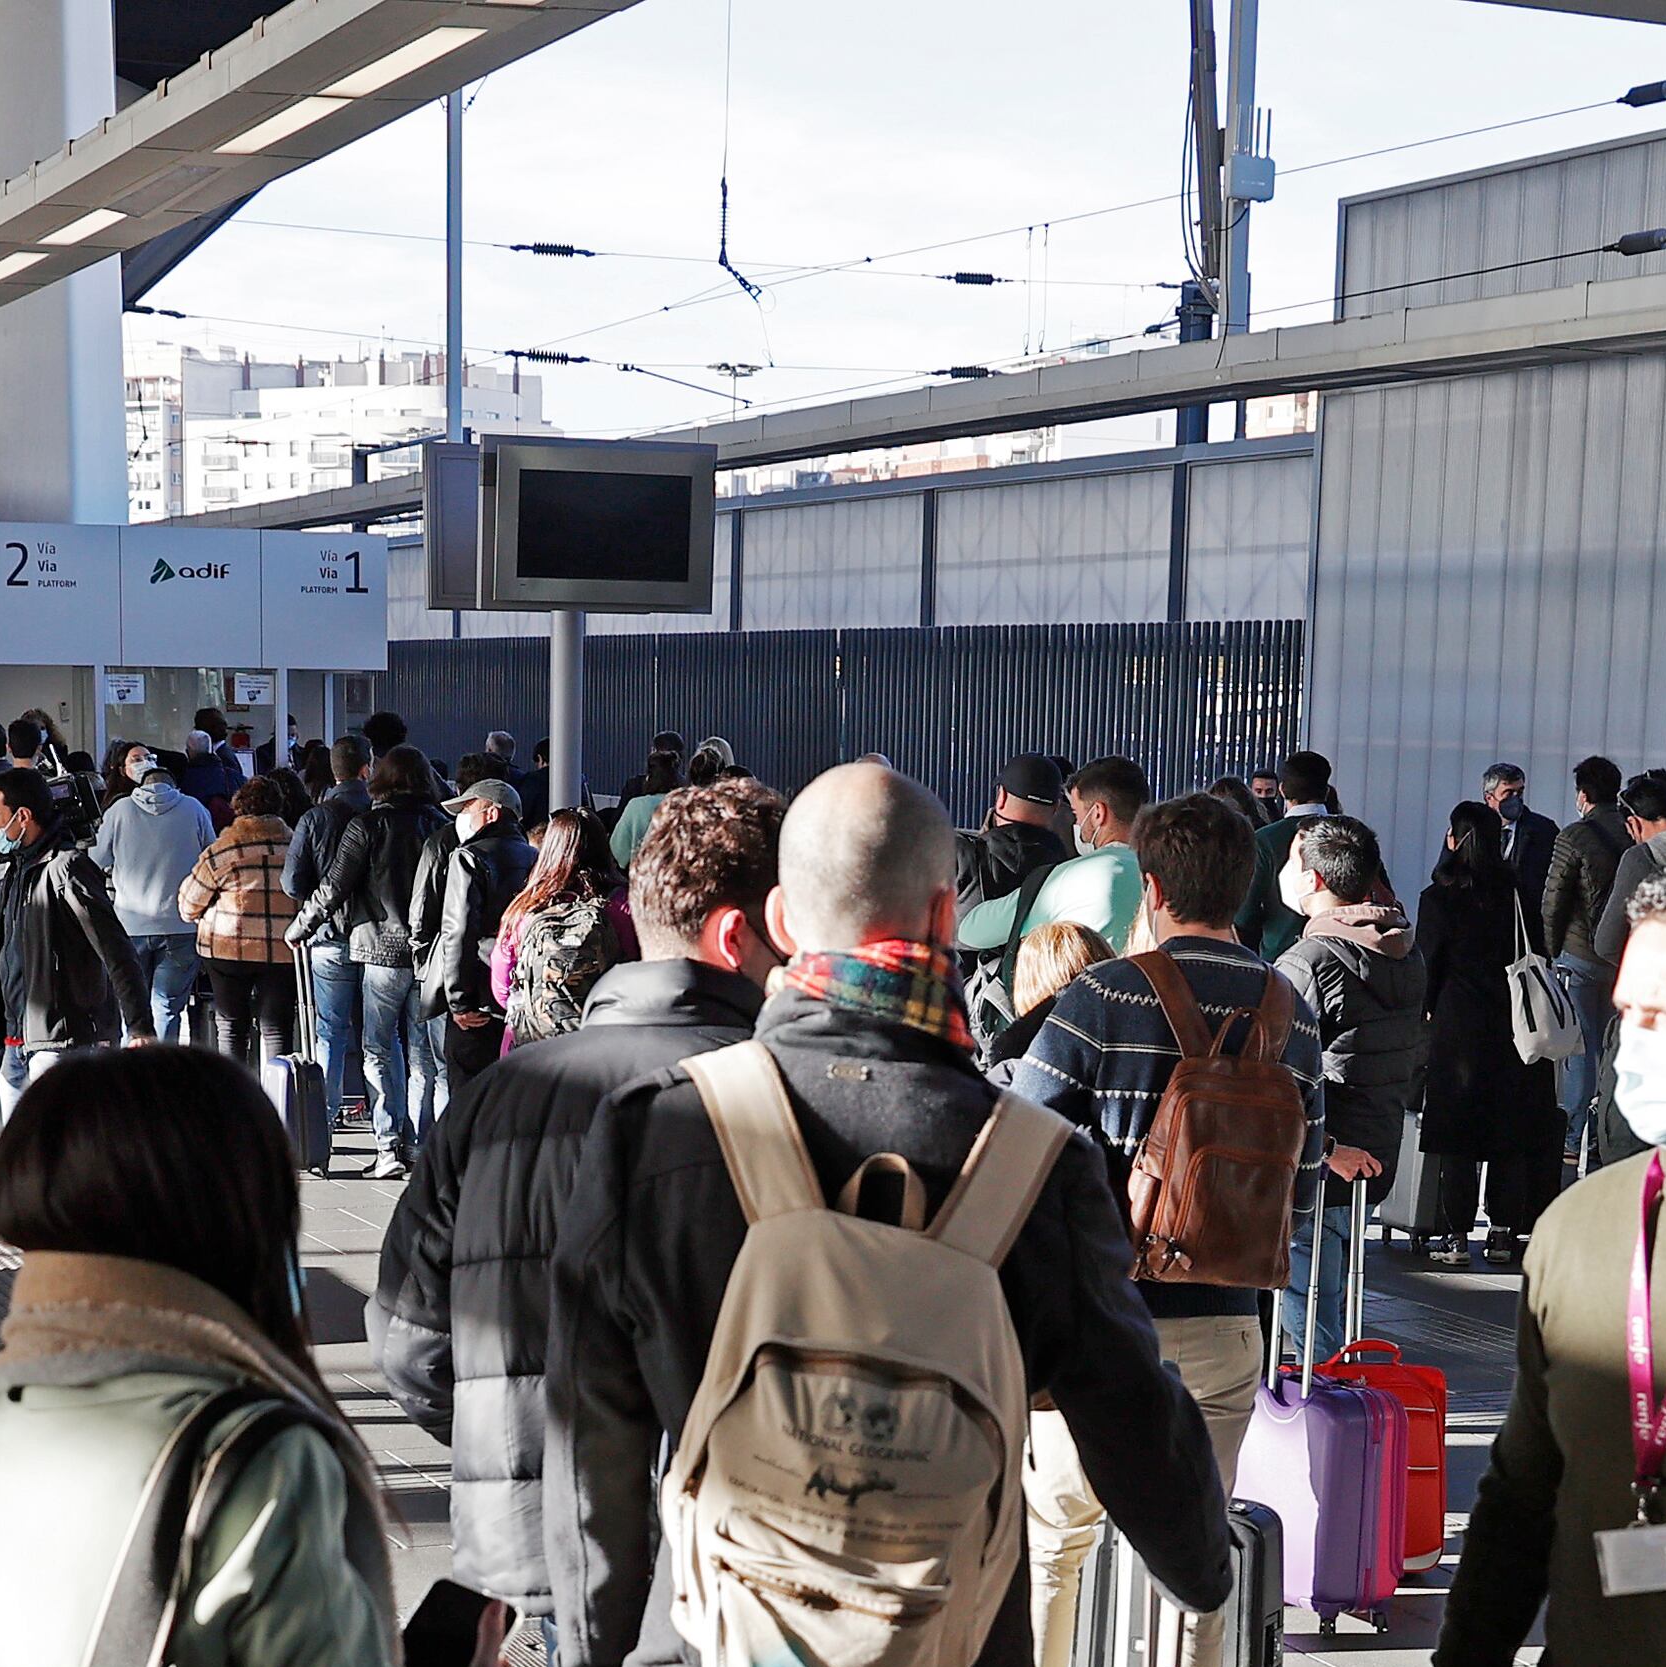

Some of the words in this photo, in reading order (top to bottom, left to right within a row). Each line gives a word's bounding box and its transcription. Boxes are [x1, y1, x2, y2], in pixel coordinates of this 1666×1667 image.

[5, 542, 29, 587] 2
[37, 542, 56, 555] Vía
[37, 560, 57, 572] Via
[178, 562, 231, 579] adif
[319, 549, 338, 562] Vía
[344, 551, 369, 594] 1
[319, 567, 338, 579] Via
[37, 580, 77, 588] PLATFORM
[300, 585, 338, 594] PLATFORM
